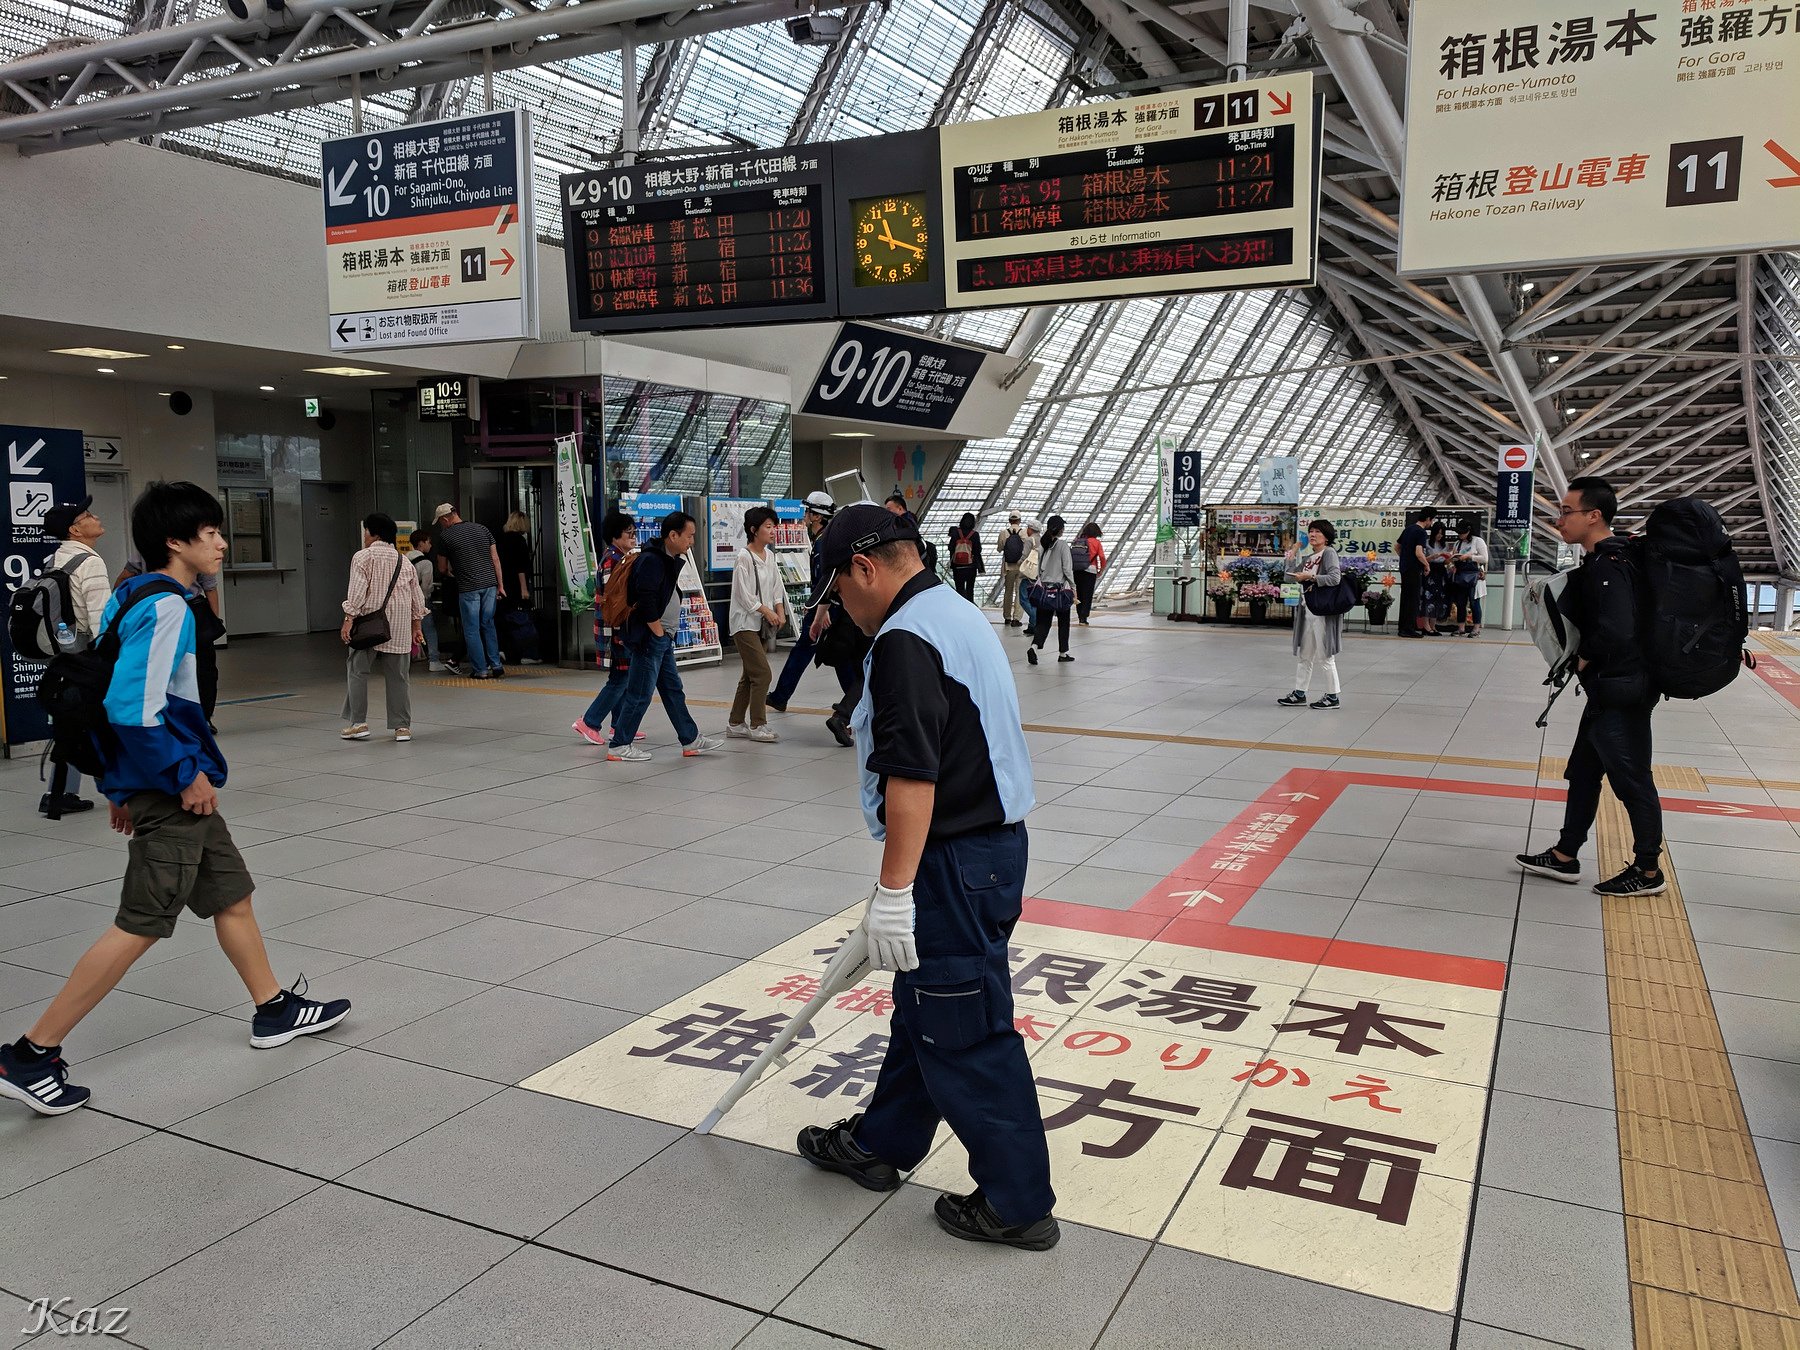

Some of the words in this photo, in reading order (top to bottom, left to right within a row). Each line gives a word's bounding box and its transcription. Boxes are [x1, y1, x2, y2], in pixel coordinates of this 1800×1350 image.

[1680, 4, 1800, 48] 強羅方
[1438, 8, 1658, 81] 箱根湯本
[1677, 56, 1704, 69] For
[1708, 51, 1746, 65] Gora
[1436, 89, 1459, 100] For
[1462, 74, 1576, 97] Hakone-Yumoto
[1135, 107, 1179, 124] 強羅方面
[1203, 103, 1215, 123] 7
[1231, 97, 1254, 119] 11
[1058, 109, 1127, 134] 箱根湯本
[1069, 130, 1118, 141] Hakone-Yumoto
[1228, 127, 1275, 144] 発車時刻
[367, 138, 383, 171] 9
[393, 137, 440, 159] 相模大野
[1235, 141, 1266, 152] Dep.Time
[394, 162, 417, 180] 新宿
[422, 154, 470, 177] 千代田線
[474, 154, 493, 170] 方面
[800, 159, 818, 171] 方面
[968, 164, 993, 175] のりば
[1108, 158, 1143, 167] Destination
[1081, 165, 1170, 198] 箱根湯本
[1217, 153, 1271, 182] 11:21
[1431, 152, 1650, 203] 箱根登山電車
[1677, 151, 1729, 193] 11
[394, 185, 408, 196] For
[410, 178, 467, 195] Sagami-Ono,
[661, 186, 696, 197] Sagami-Ono
[705, 182, 731, 191] Shinjuku
[739, 177, 778, 187] Chiyoda-Line
[773, 186, 807, 199] 発車時刻
[363, 185, 390, 218] 10
[411, 193, 452, 208] Shinjuku,
[455, 187, 491, 203] Chiyoda
[494, 185, 513, 197] Line
[581, 209, 600, 219] のりば
[870, 210, 882, 220] 11
[884, 202, 897, 213] 12
[902, 205, 908, 216] 1
[971, 213, 990, 235] 11
[1000, 204, 1062, 231] 各駅停車
[1082, 191, 1170, 224] 箱根湯本
[1217, 181, 1274, 209] 11:27
[1429, 207, 1481, 222] Hakone
[1485, 203, 1526, 217] Tozan
[1529, 198, 1586, 213] Railway
[589, 229, 599, 245] 9
[608, 223, 655, 246] 各駅停車
[768, 209, 811, 230] 11:20
[862, 223, 874, 234] 10
[912, 217, 920, 227] 2
[859, 239, 867, 249] 9
[917, 233, 925, 243] 3
[1070, 235, 1107, 246] おしらせ
[1111, 229, 1161, 243] Information
[410, 248, 450, 265] 強羅方面
[587, 251, 603, 269] 10
[769, 231, 812, 254] 11:26
[913, 250, 921, 259] 4
[342, 247, 404, 271] 箱根湯本
[464, 253, 483, 276] 11
[864, 254, 872, 264] 8
[589, 273, 604, 290] 10
[611, 267, 656, 289] 快速急行
[770, 254, 812, 276] 11:34
[875, 265, 882, 276] 7
[889, 269, 897, 279] 6
[903, 263, 911, 273] 5
[387, 274, 451, 293] 箱根登山電車
[593, 294, 603, 311] 9
[771, 277, 813, 299] 11:36
[379, 312, 438, 328] お忘れ物取扱所
[379, 330, 392, 340] Lost
[394, 330, 405, 338] and
[408, 328, 427, 338] Found
[429, 326, 448, 336] Office
[918, 355, 947, 371] 相模大野
[912, 367, 928, 380] 新宿
[928, 370, 953, 384] 千代田線
[951, 376, 967, 388] 方面
[1182, 456, 1192, 471] 9
[1178, 476, 1195, 492] 10
[1510, 473, 1519, 484] 8
[1508, 485, 1519, 518] 降車専用
[845, 964, 860, 980] Hitachi
